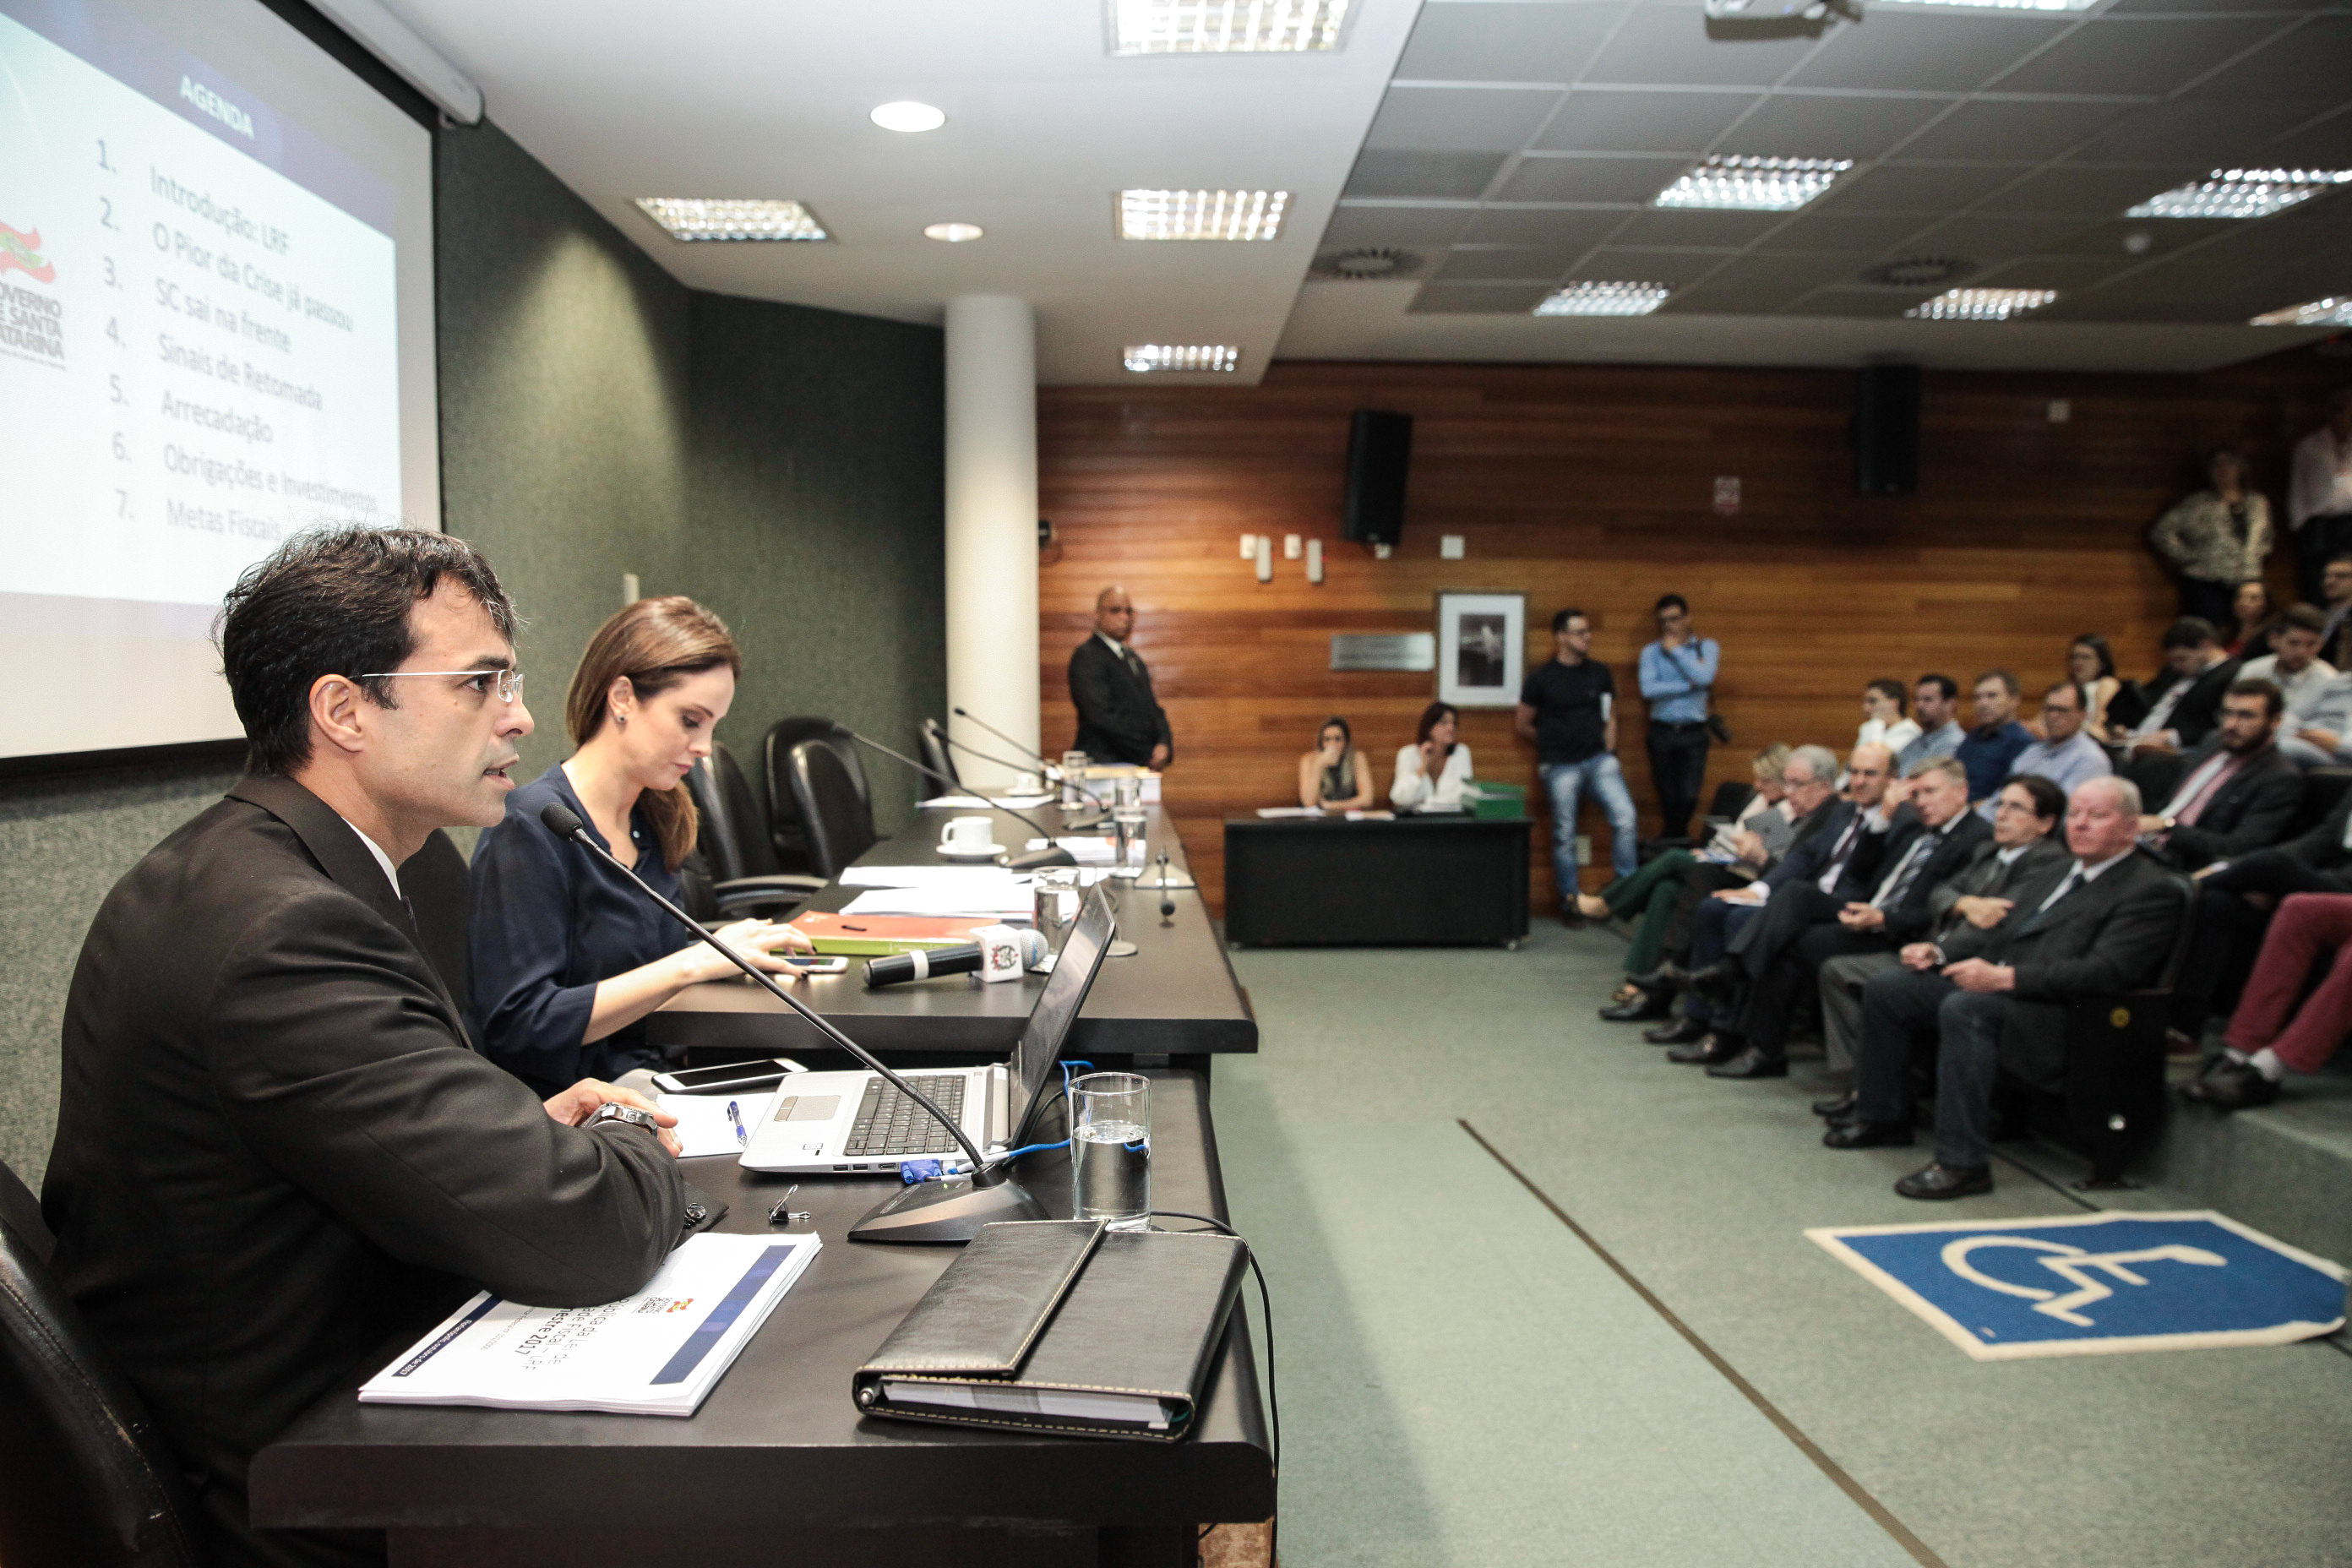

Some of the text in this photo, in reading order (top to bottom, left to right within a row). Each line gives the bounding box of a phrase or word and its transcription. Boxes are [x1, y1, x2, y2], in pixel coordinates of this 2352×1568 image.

[179, 74, 255, 140] AGENDA
[96, 138, 118, 174] 1.
[260, 220, 290, 257] LRF
[99, 196, 121, 232] 2.
[153, 222, 170, 253] O
[174, 229, 213, 270] Pior
[217, 253, 240, 284] da
[242, 262, 284, 303] Crise
[304, 295, 354, 333] passou
[0, 280, 63, 319] OVERNO
[10, 306, 63, 340] SANTA
[103, 255, 291, 354] 3. SC sai na frente
[0, 323, 65, 361] ATARINA
[106, 315, 323, 413] 4. Sinais de Retomada
[109, 372, 274, 445] 5. Arrecadação
[111, 430, 133, 464] 6.
[163, 443, 264, 492] Obrigações
[266, 471, 278, 493] e
[115, 488, 137, 521] 7.
[166, 497, 226, 536] Metas
[514, 1334, 548, 1355] 2017
[545, 1323, 582, 1345] Fiscal
